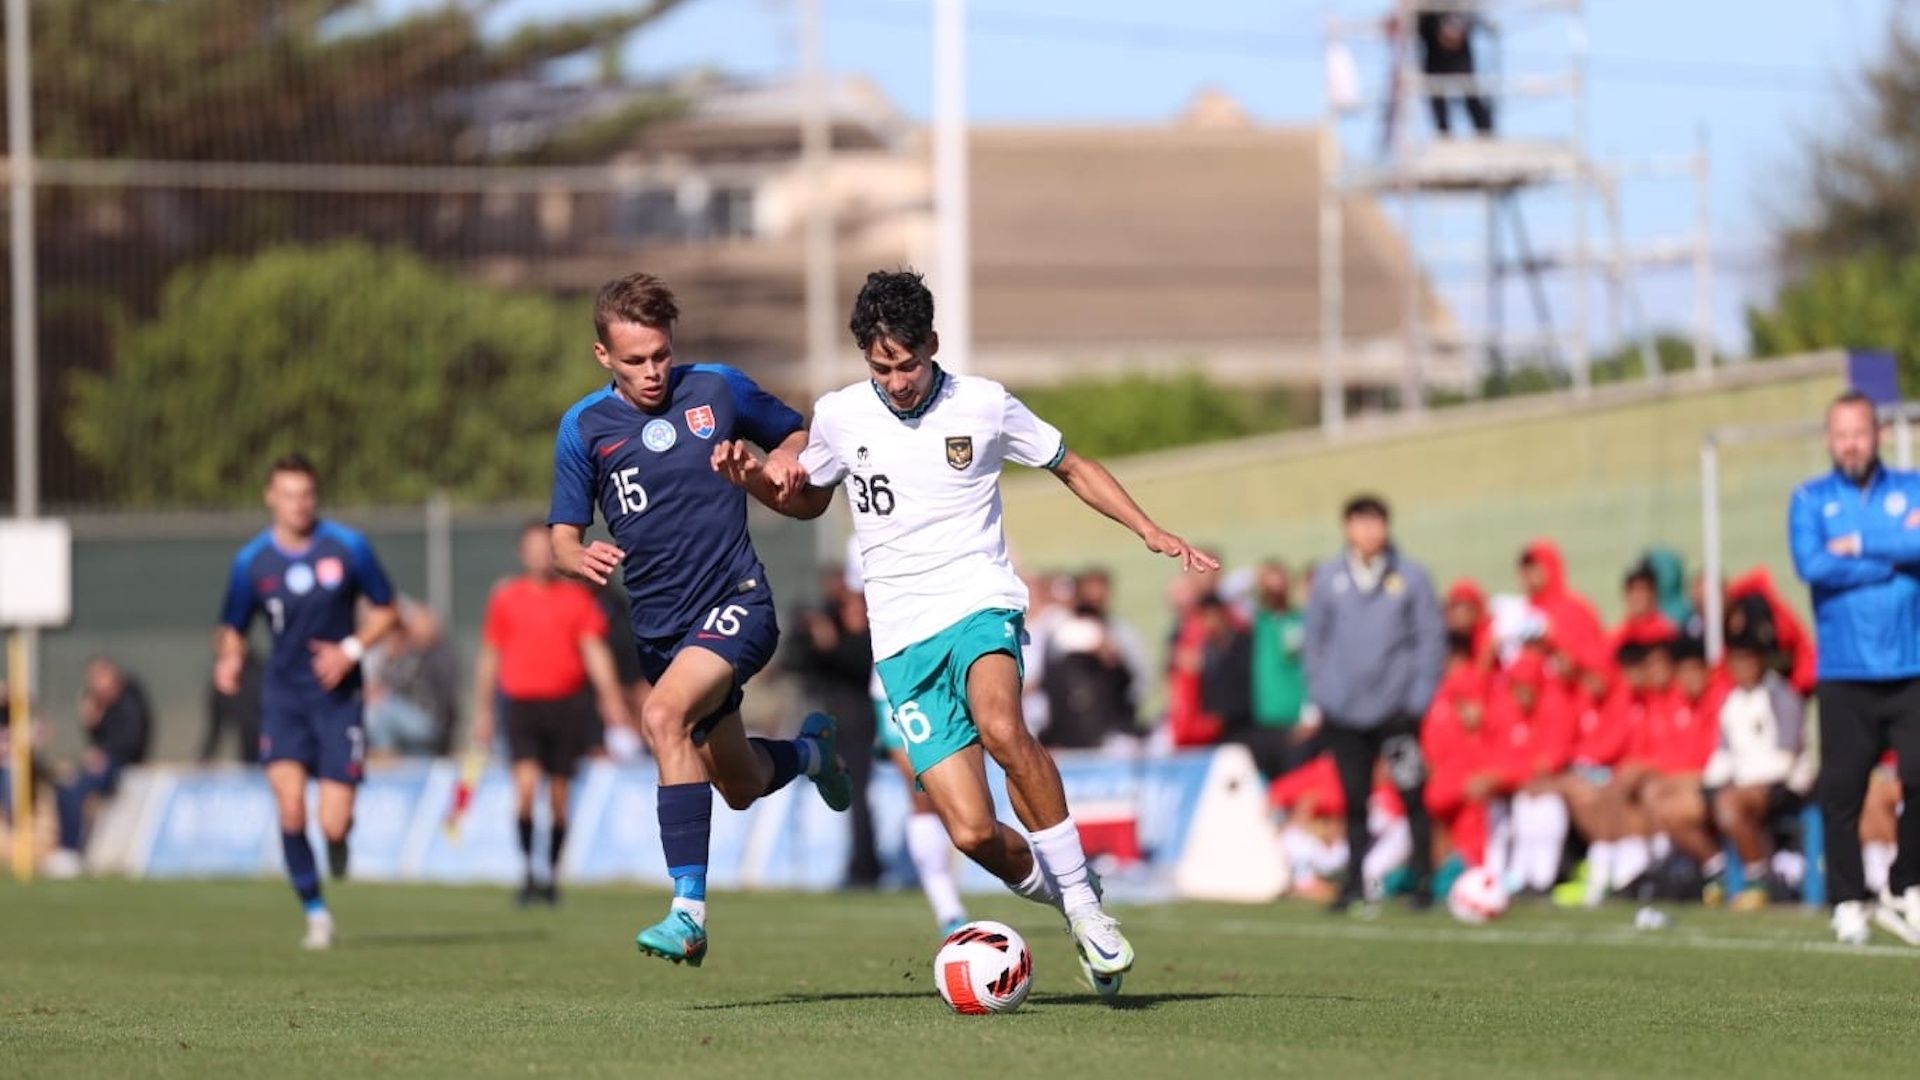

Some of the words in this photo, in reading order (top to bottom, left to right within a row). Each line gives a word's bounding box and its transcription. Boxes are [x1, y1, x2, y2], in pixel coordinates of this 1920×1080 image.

[610, 467, 648, 515] 15
[853, 474, 896, 516] 36
[702, 604, 749, 636] 15
[893, 700, 932, 746] 6
